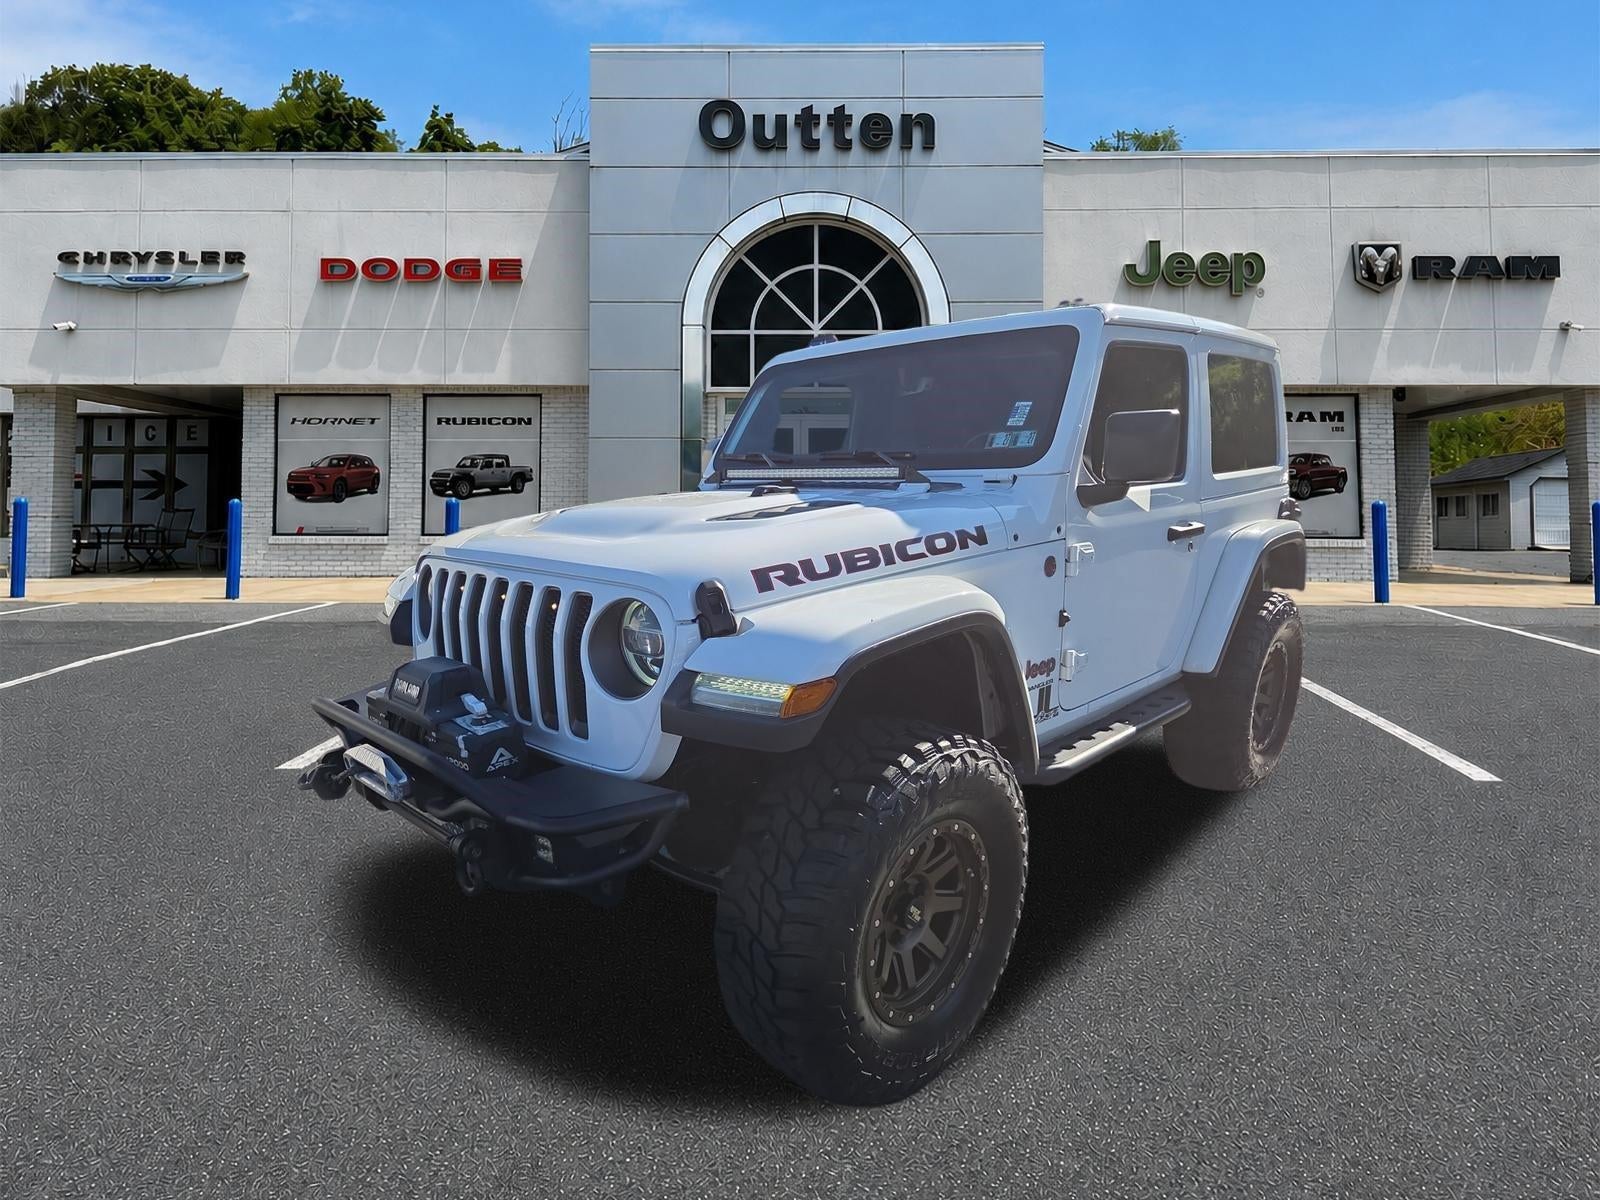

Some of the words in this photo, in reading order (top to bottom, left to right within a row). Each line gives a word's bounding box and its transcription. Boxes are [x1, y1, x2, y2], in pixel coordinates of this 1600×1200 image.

[698, 99, 936, 150] Outten
[56, 250, 247, 265] CHRYSLER
[319, 257, 523, 283] DODGE
[1123, 240, 1266, 296] Jeep
[1411, 255, 1561, 280] RAM
[290, 417, 381, 425] HORNET
[436, 417, 533, 426] RUBICON
[750, 525, 989, 594] RUBICON
[1025, 657, 1056, 681] Jeep
